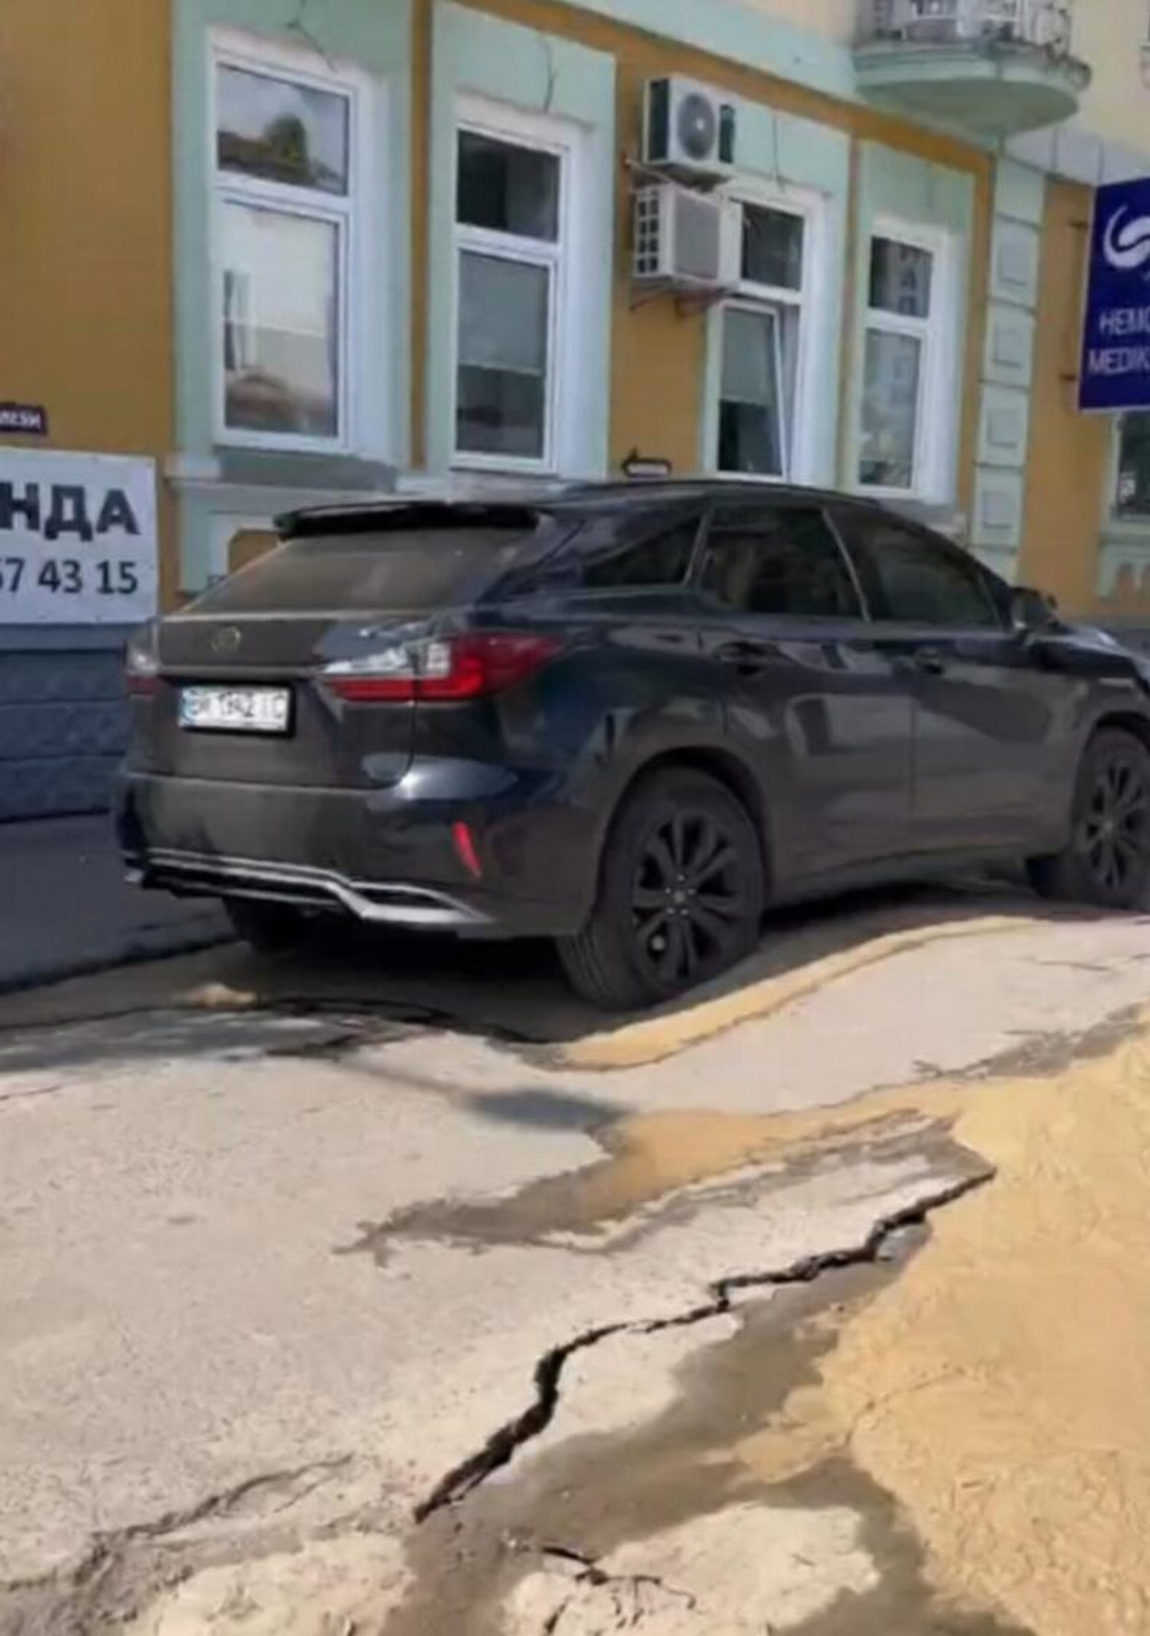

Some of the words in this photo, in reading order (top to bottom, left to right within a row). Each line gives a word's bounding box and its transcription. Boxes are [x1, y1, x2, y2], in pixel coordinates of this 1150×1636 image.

[0, 556, 25, 593] 7
[37, 558, 83, 594] 43
[96, 559, 139, 595] 15
